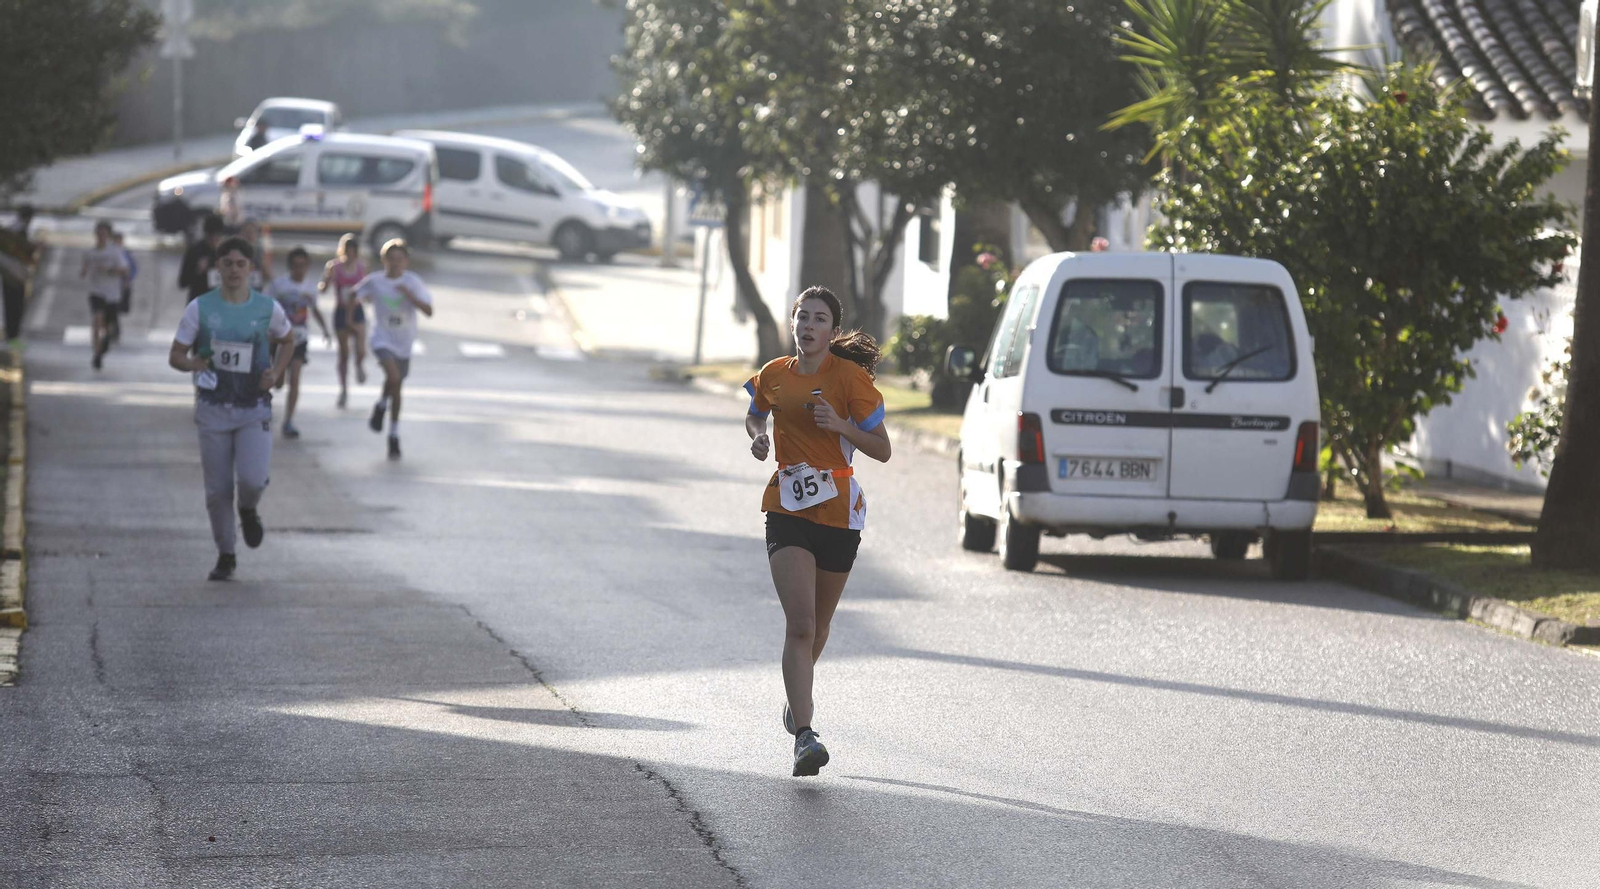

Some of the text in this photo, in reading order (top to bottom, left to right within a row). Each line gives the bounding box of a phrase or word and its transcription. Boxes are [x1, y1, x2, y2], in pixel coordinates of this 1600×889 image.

[220, 350, 241, 367] 91
[1061, 411, 1127, 424] CITROËN
[1069, 460, 1151, 479] 7644 BBN
[792, 475, 819, 501] 95
